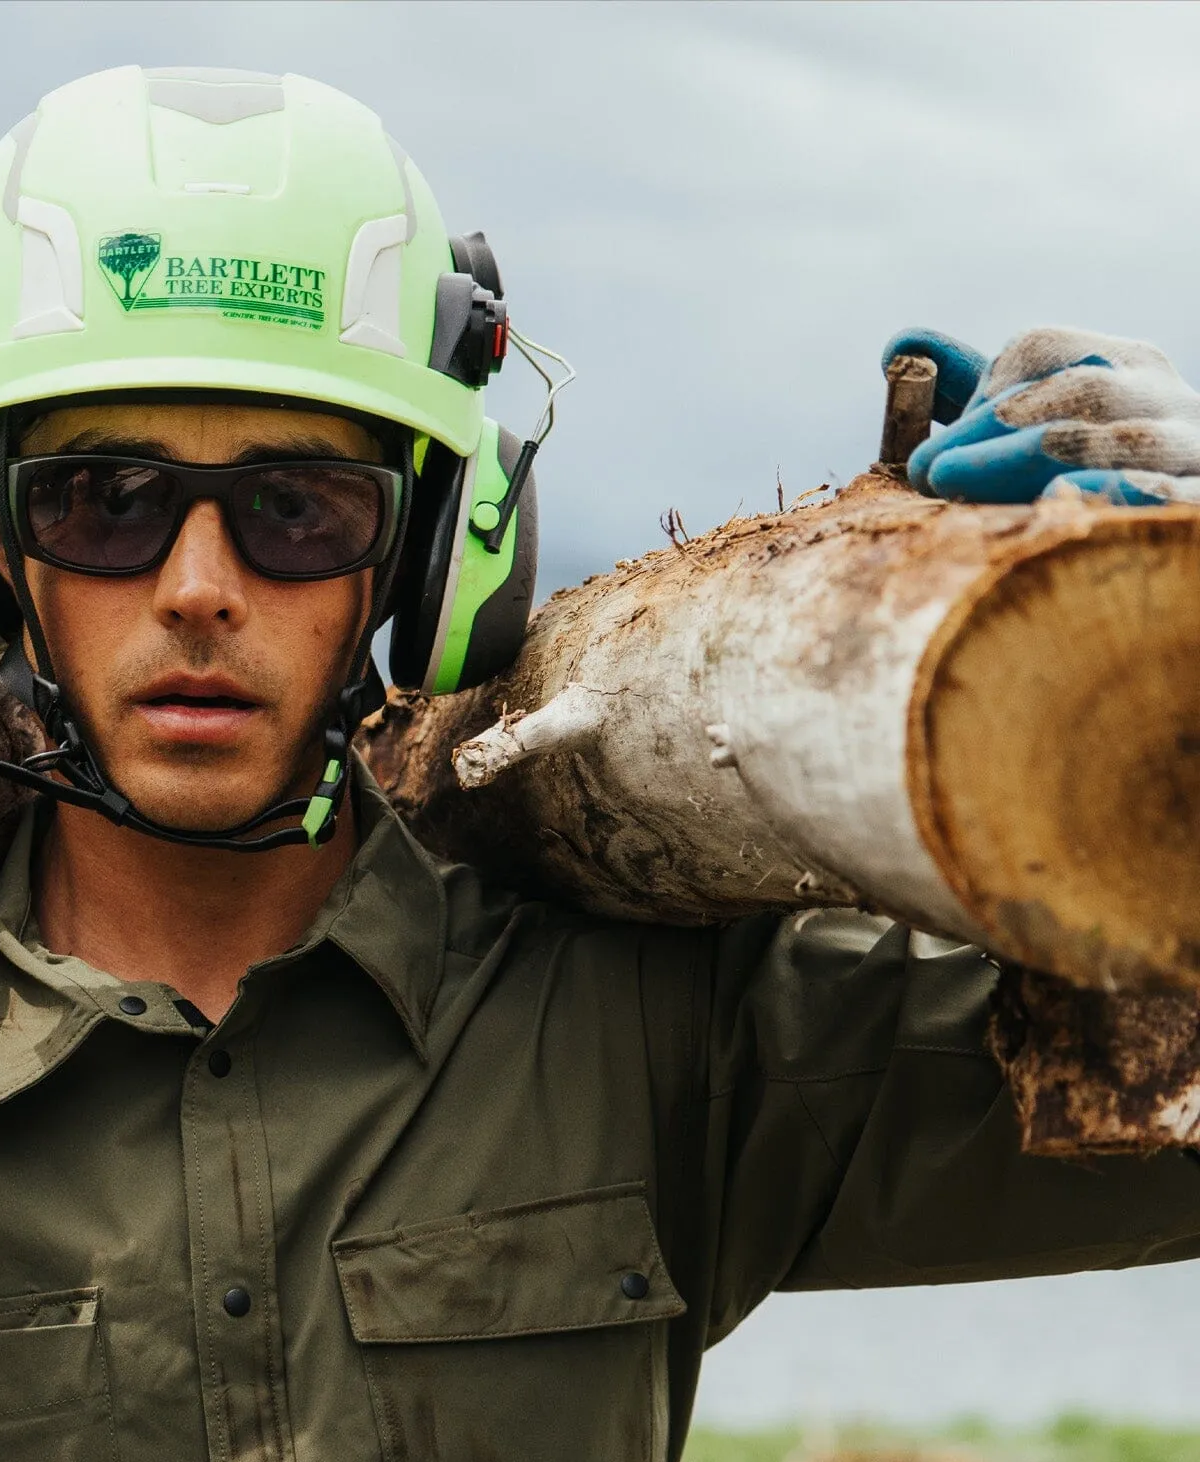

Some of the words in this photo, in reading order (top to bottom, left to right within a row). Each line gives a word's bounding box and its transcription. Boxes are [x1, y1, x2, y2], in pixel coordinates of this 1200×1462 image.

[100, 244, 159, 257] BARTLETT
[165, 257, 325, 291] BARTLETT
[165, 279, 223, 295] TREE
[230, 282, 323, 308] EXPERTS
